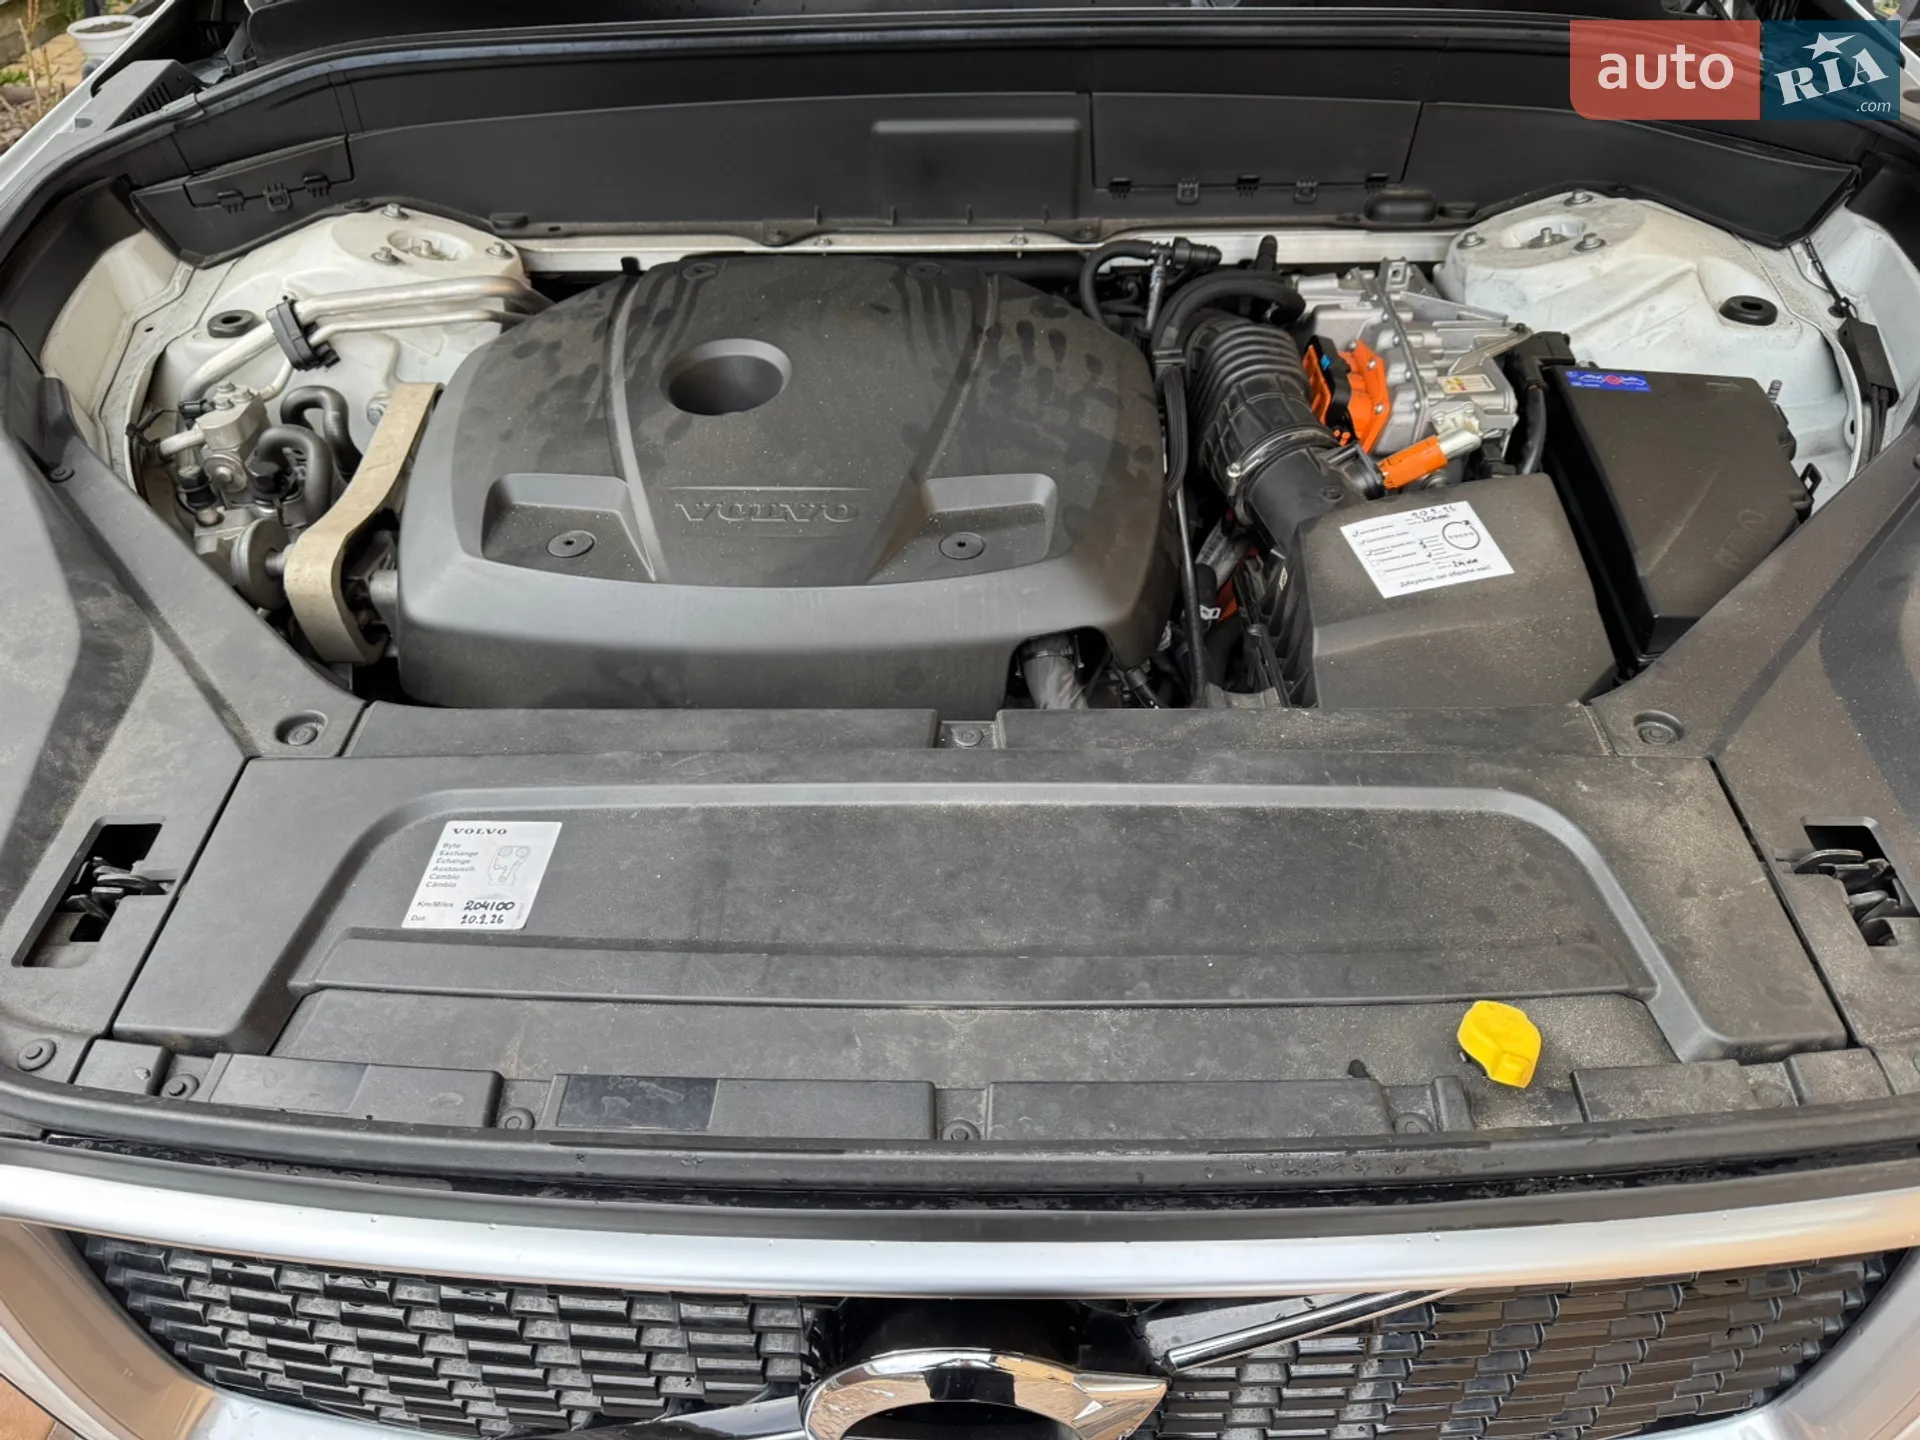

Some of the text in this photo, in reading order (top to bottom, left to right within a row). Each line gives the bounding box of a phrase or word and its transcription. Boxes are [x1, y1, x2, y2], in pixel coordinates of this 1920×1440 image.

[674, 502, 860, 523] VOLVO
[453, 827, 507, 836] VOLVO
[439, 850, 479, 858] Exchange
[463, 900, 515, 911] 204100
